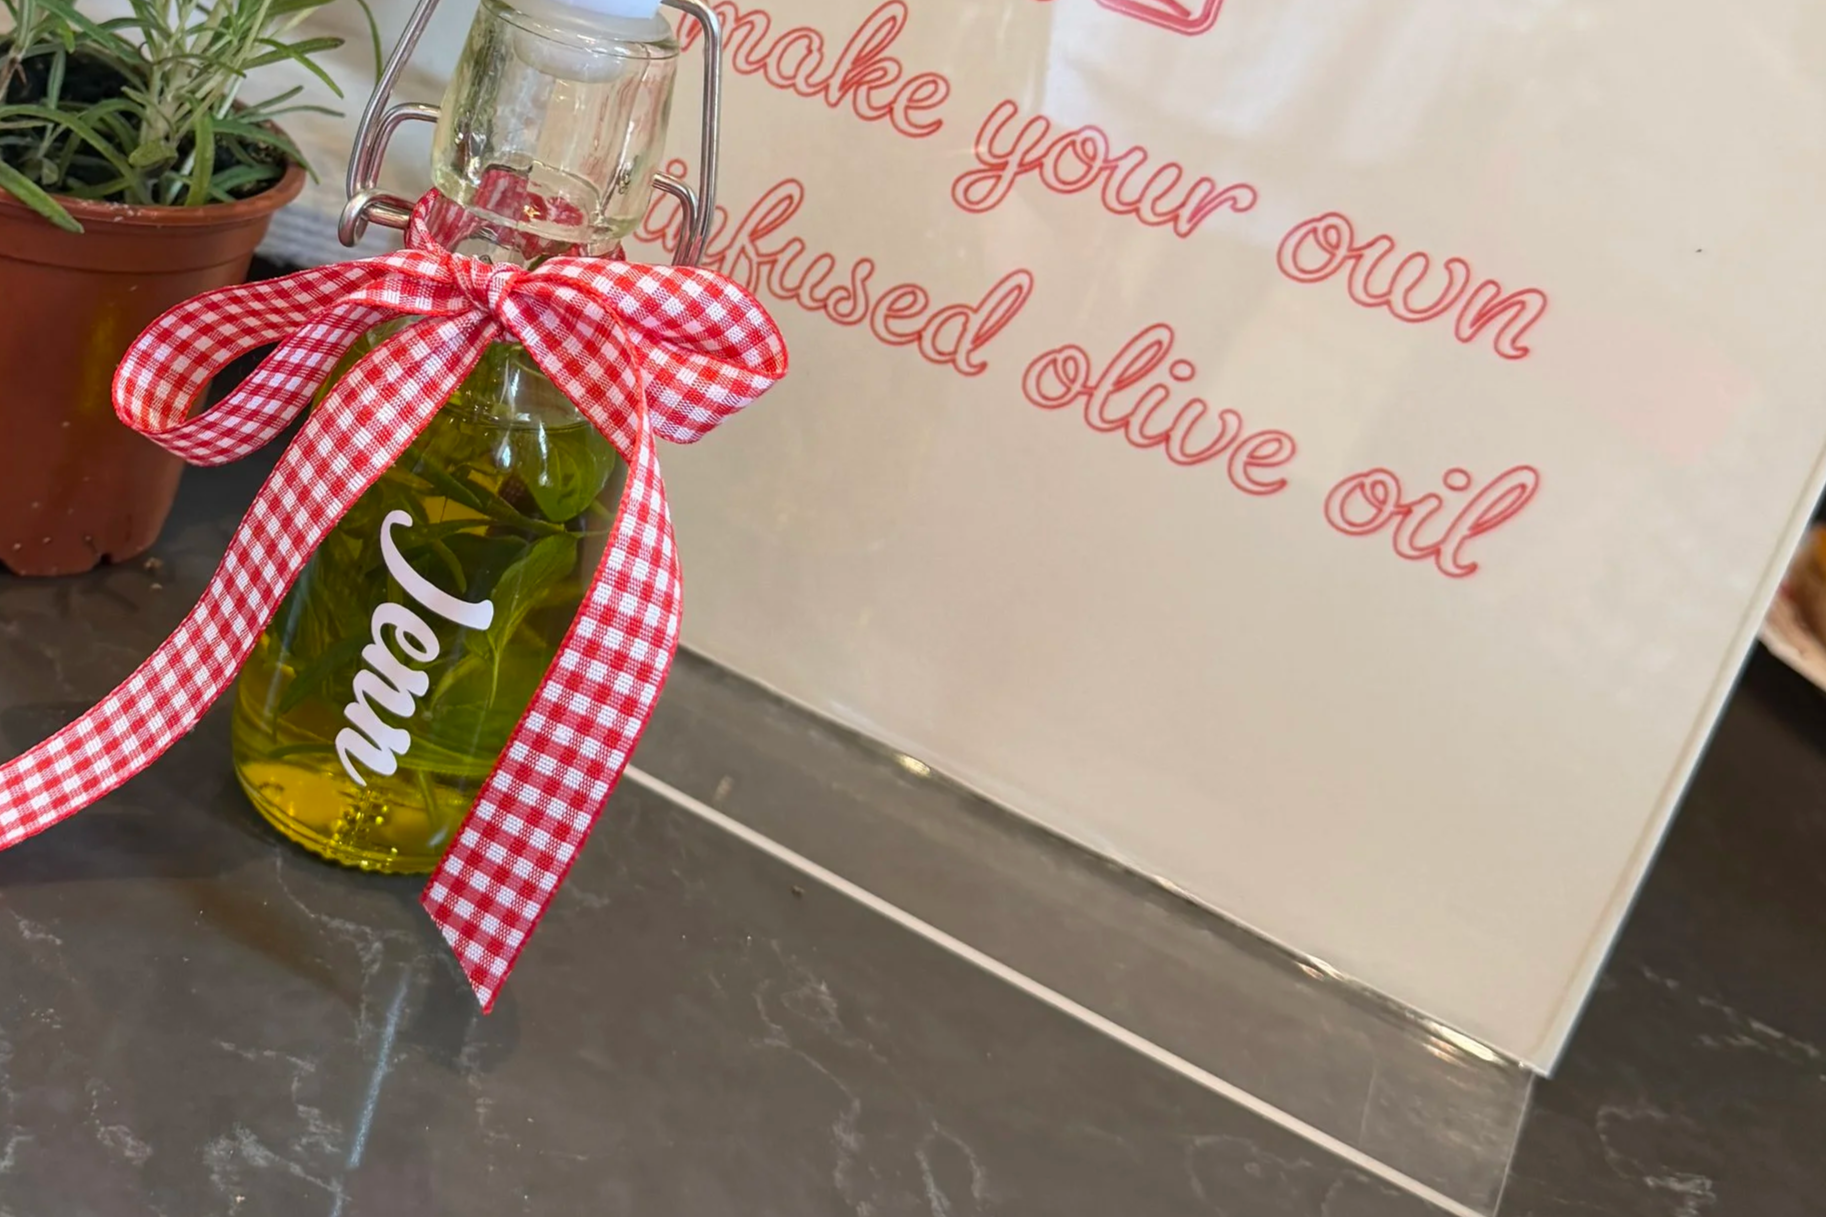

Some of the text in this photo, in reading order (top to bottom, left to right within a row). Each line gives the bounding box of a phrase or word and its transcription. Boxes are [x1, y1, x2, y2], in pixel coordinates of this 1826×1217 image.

[950, 99, 1258, 239] your
[1276, 211, 1549, 360] own
[1021, 322, 1297, 496] olive
[1323, 464, 1541, 579] oil
[334, 509, 495, 787] Jenn
